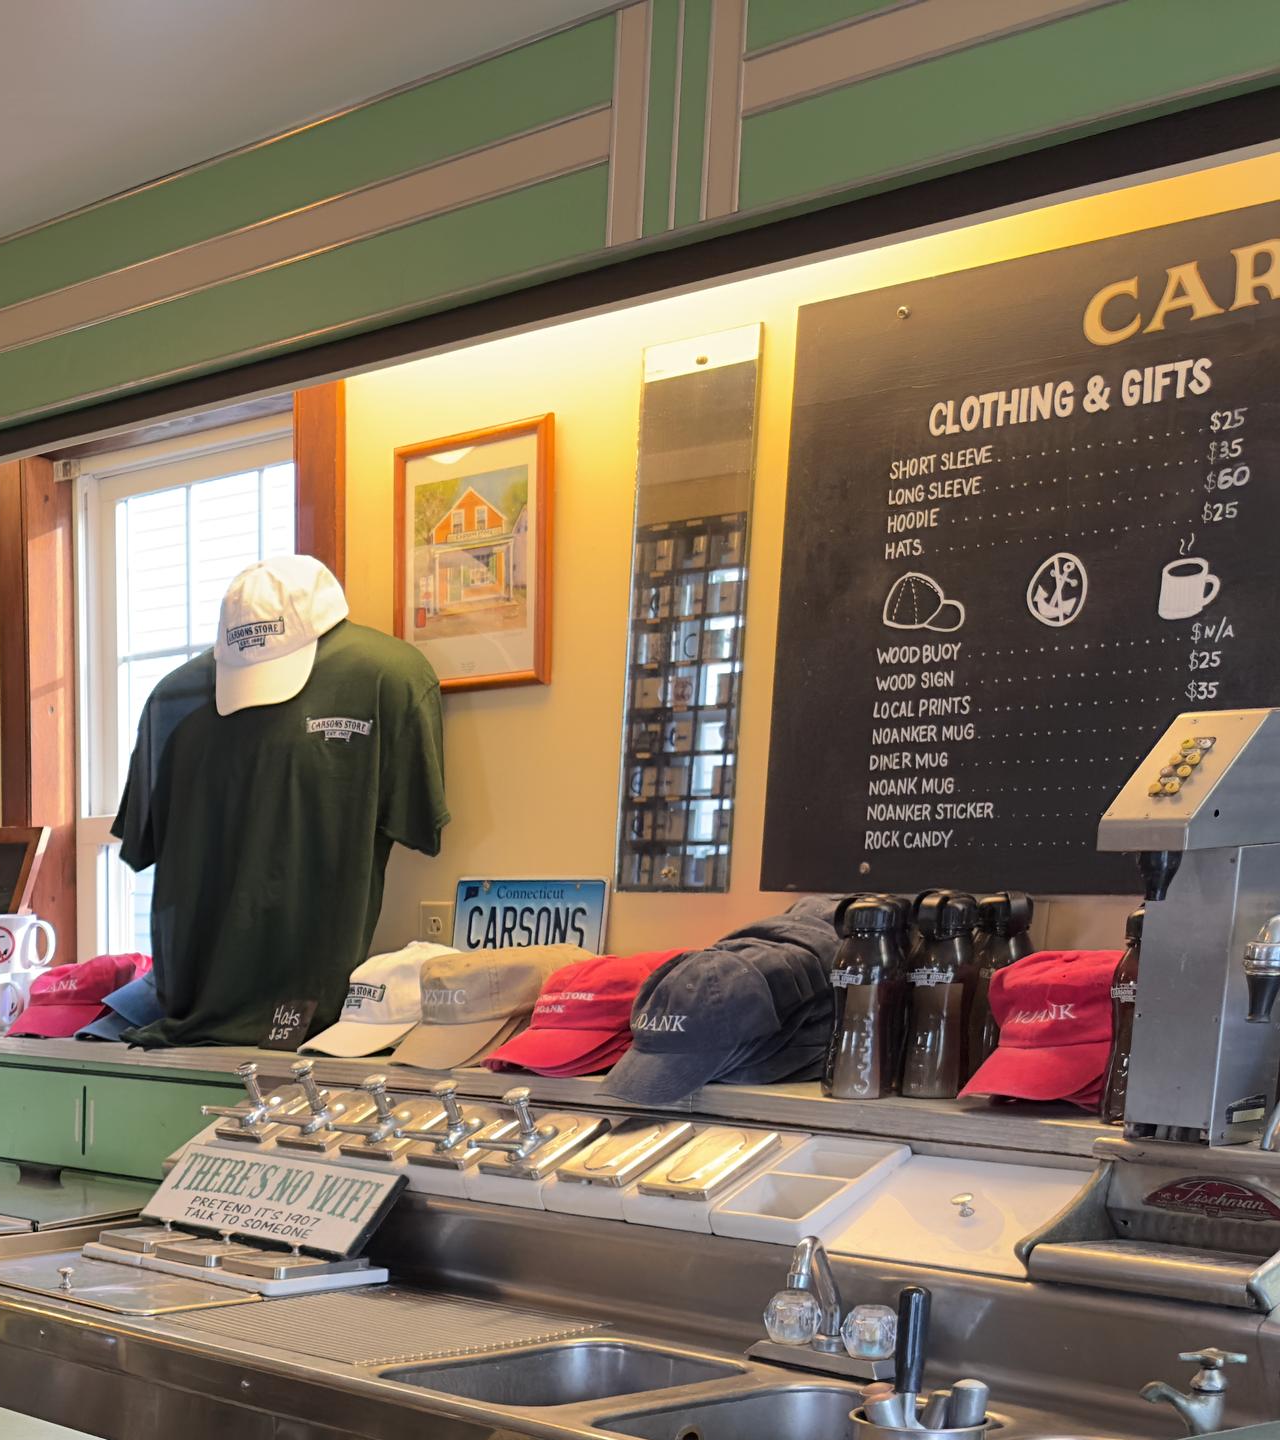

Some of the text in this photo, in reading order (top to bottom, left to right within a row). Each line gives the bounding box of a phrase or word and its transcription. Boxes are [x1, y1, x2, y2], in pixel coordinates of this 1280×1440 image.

[928, 357, 1213, 437] CLOTHING & GIFTS
[889, 407, 1248, 480] SHORT SLEEVE $25
[887, 465, 1251, 533] HOODIE $60
[888, 484, 925, 505] LONG
[927, 476, 982, 500] SLEEVE
[884, 501, 1239, 560] HATS $25
[229, 624, 278, 642] CARSONS STORE
[876, 646, 920, 665] WOOD
[922, 642, 961, 664] BUOY
[876, 650, 1221, 691] WOOD SIGN $25
[873, 680, 1219, 719] LOCAL PRINTS $35
[311, 720, 367, 733] CARSONS STORE
[872, 723, 975, 745] NOANKER MUG
[869, 752, 948, 771] DINER MUG
[869, 776, 954, 796] NOANK MUG
[866, 802, 994, 822] NOANKER STICKER
[864, 829, 953, 850] ROCK CANDY
[497, 885, 565, 900] Connecticut
[466, 906, 587, 949] CARSONS
[424, 989, 467, 1006] YSTIC
[560, 991, 595, 1001] STORE
[272, 1005, 301, 1026] Hats
[633, 1013, 688, 1033] OANK
[269, 1027, 292, 1040] $25
[171, 1152, 384, 1224] THERE'S NO WIFI
[190, 1196, 322, 1227] PRETEND IT'S 1907
[184, 1207, 313, 1239] TALK TO SOMEONE
